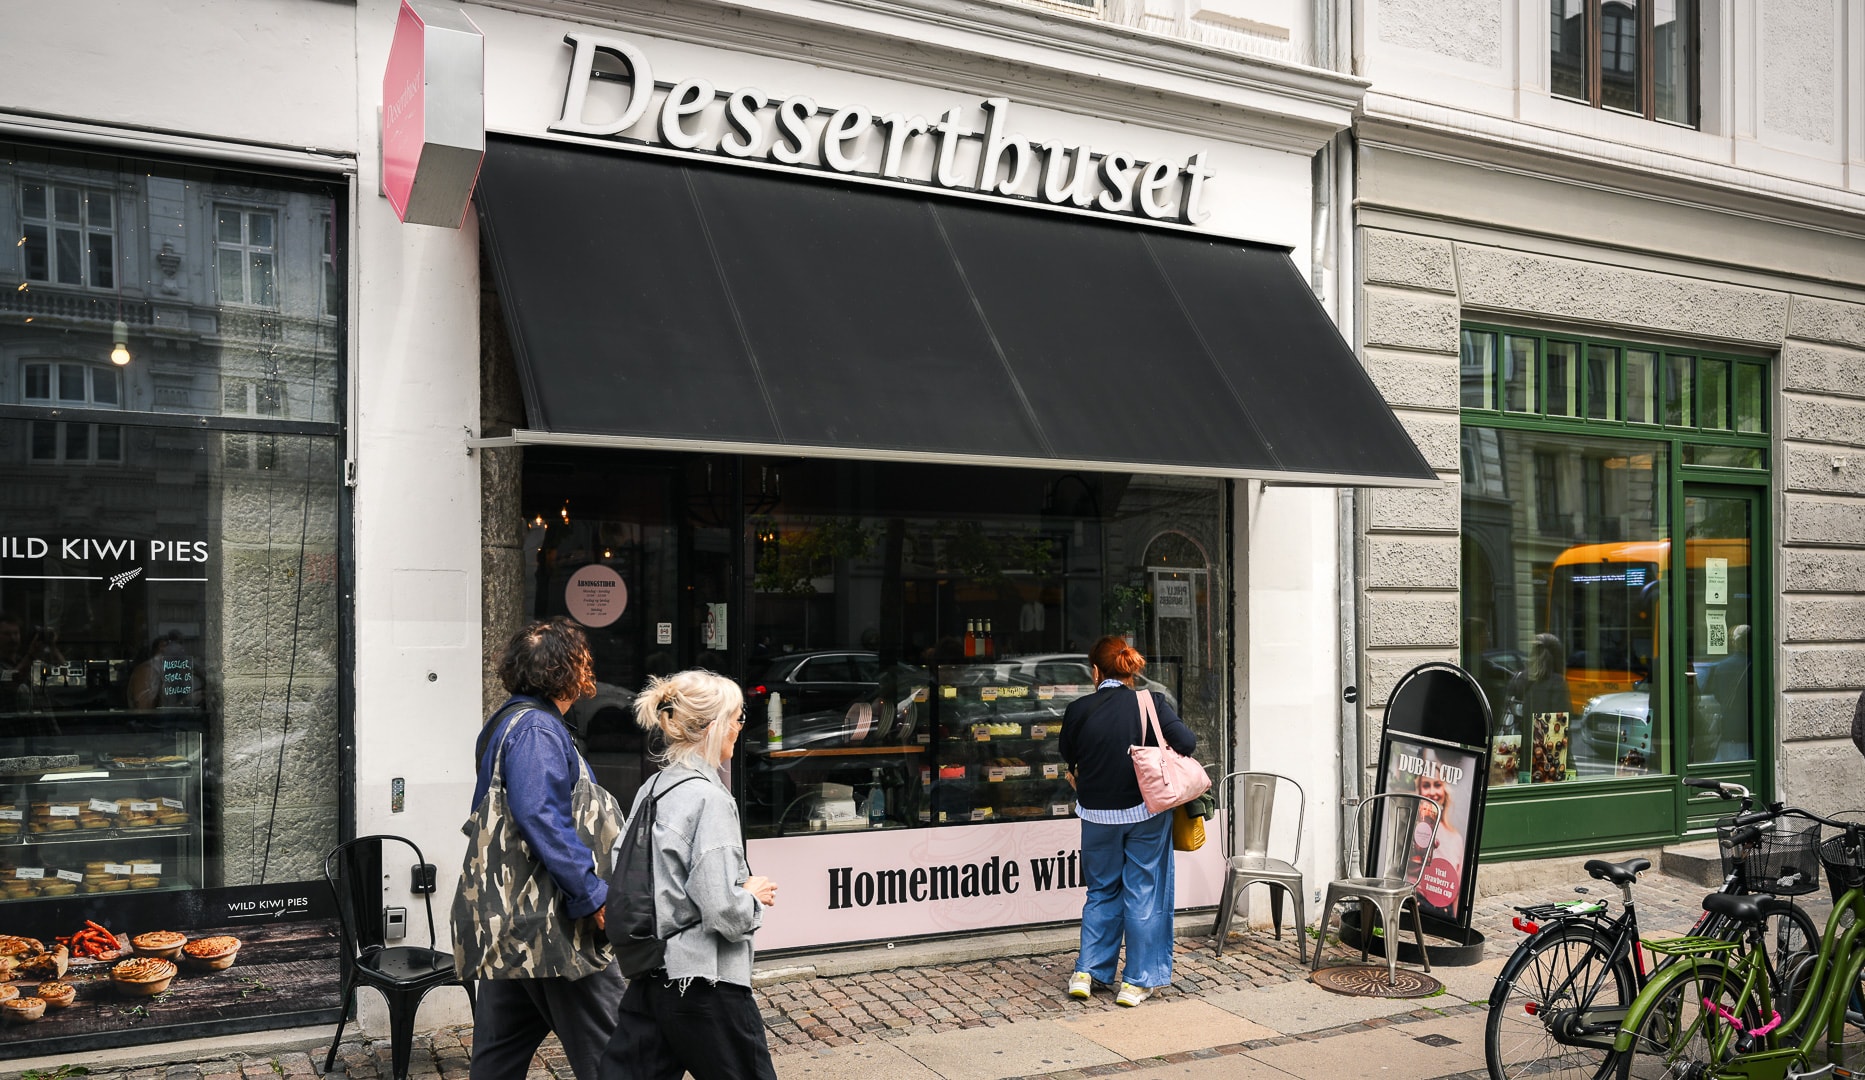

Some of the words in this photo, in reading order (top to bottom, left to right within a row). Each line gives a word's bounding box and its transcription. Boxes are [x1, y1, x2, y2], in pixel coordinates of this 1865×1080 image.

[547, 31, 1216, 224] Desserthuset
[0, 536, 49, 559] ILD
[62, 538, 135, 561] KIWI
[150, 540, 209, 562] PIES
[1398, 753, 1437, 779] DUBAI
[1439, 763, 1463, 785] CUP
[828, 855, 1020, 910] Homemade
[1424, 874, 1450, 889] strawberry
[1450, 882, 1455, 890] &
[1435, 867, 1447, 878] Viral
[228, 901, 256, 911] WILD
[259, 899, 284, 909] KIWI
[287, 897, 308, 907] PIES
[1443, 889, 1453, 899] cup
